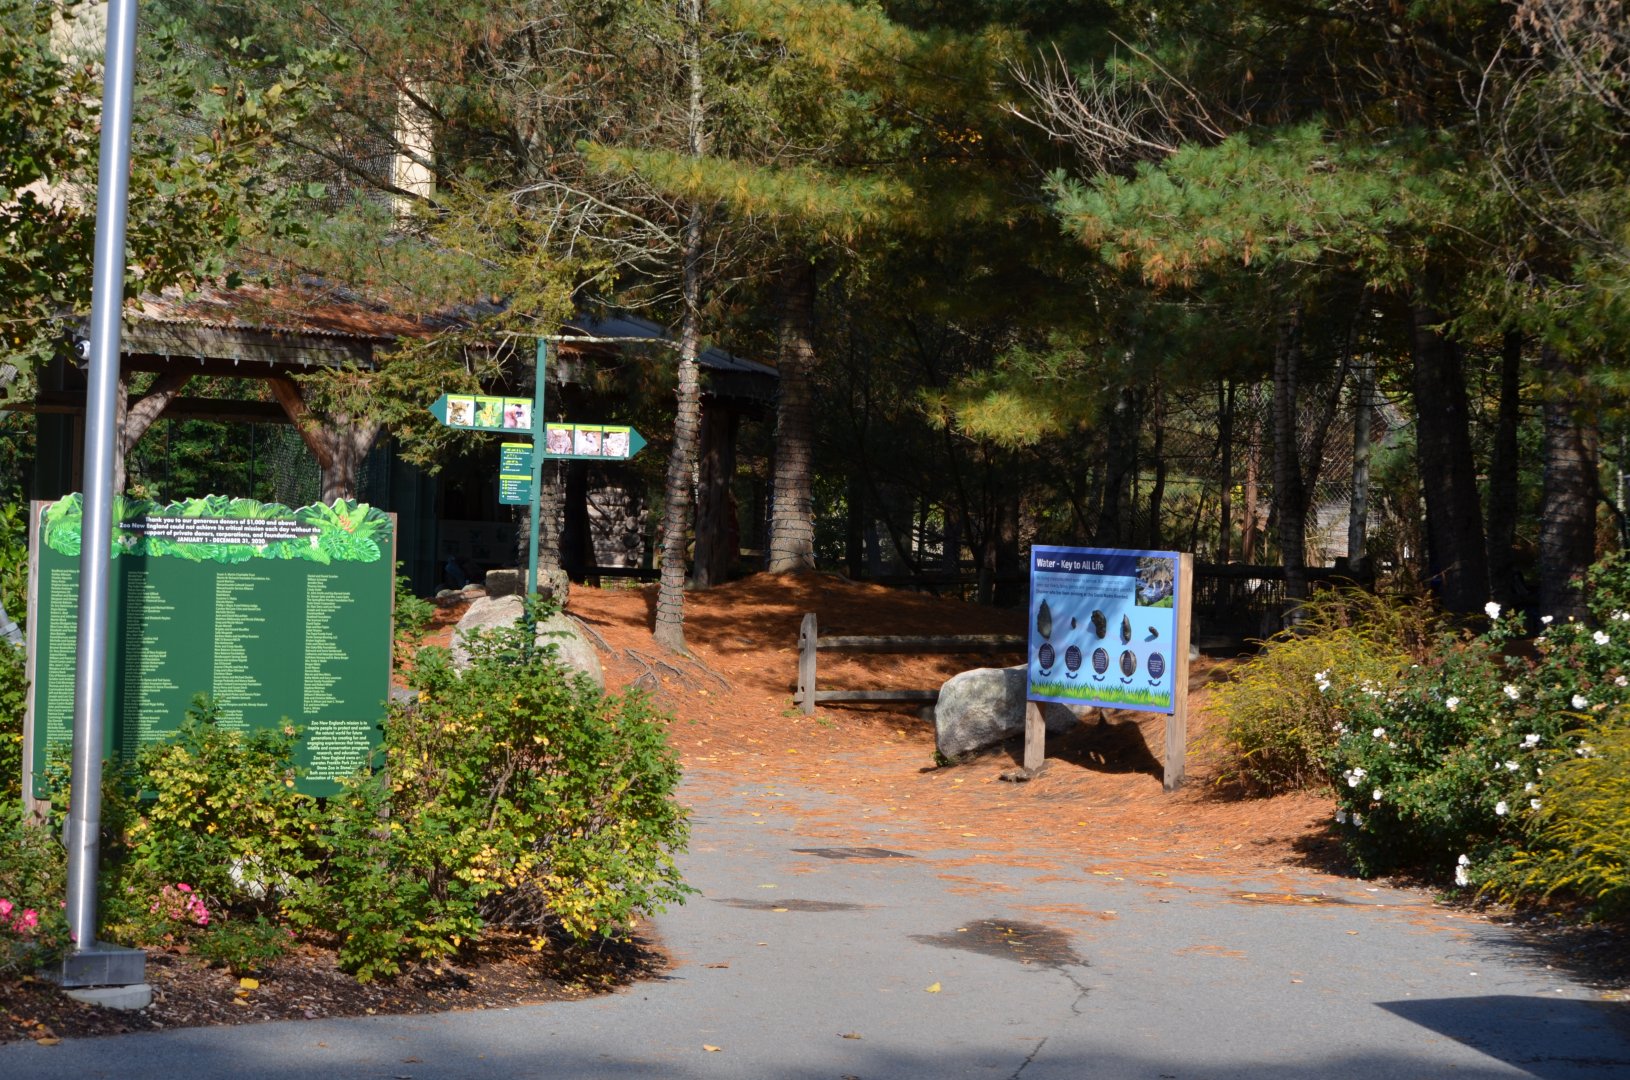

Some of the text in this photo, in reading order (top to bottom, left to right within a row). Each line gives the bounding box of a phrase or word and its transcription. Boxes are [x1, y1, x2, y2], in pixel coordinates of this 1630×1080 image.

[1037, 558, 1055, 567] Water
[1061, 560, 1072, 571] Key
[1074, 561, 1080, 569] to
[1082, 561, 1090, 570] All
[1092, 561, 1104, 571] Life
